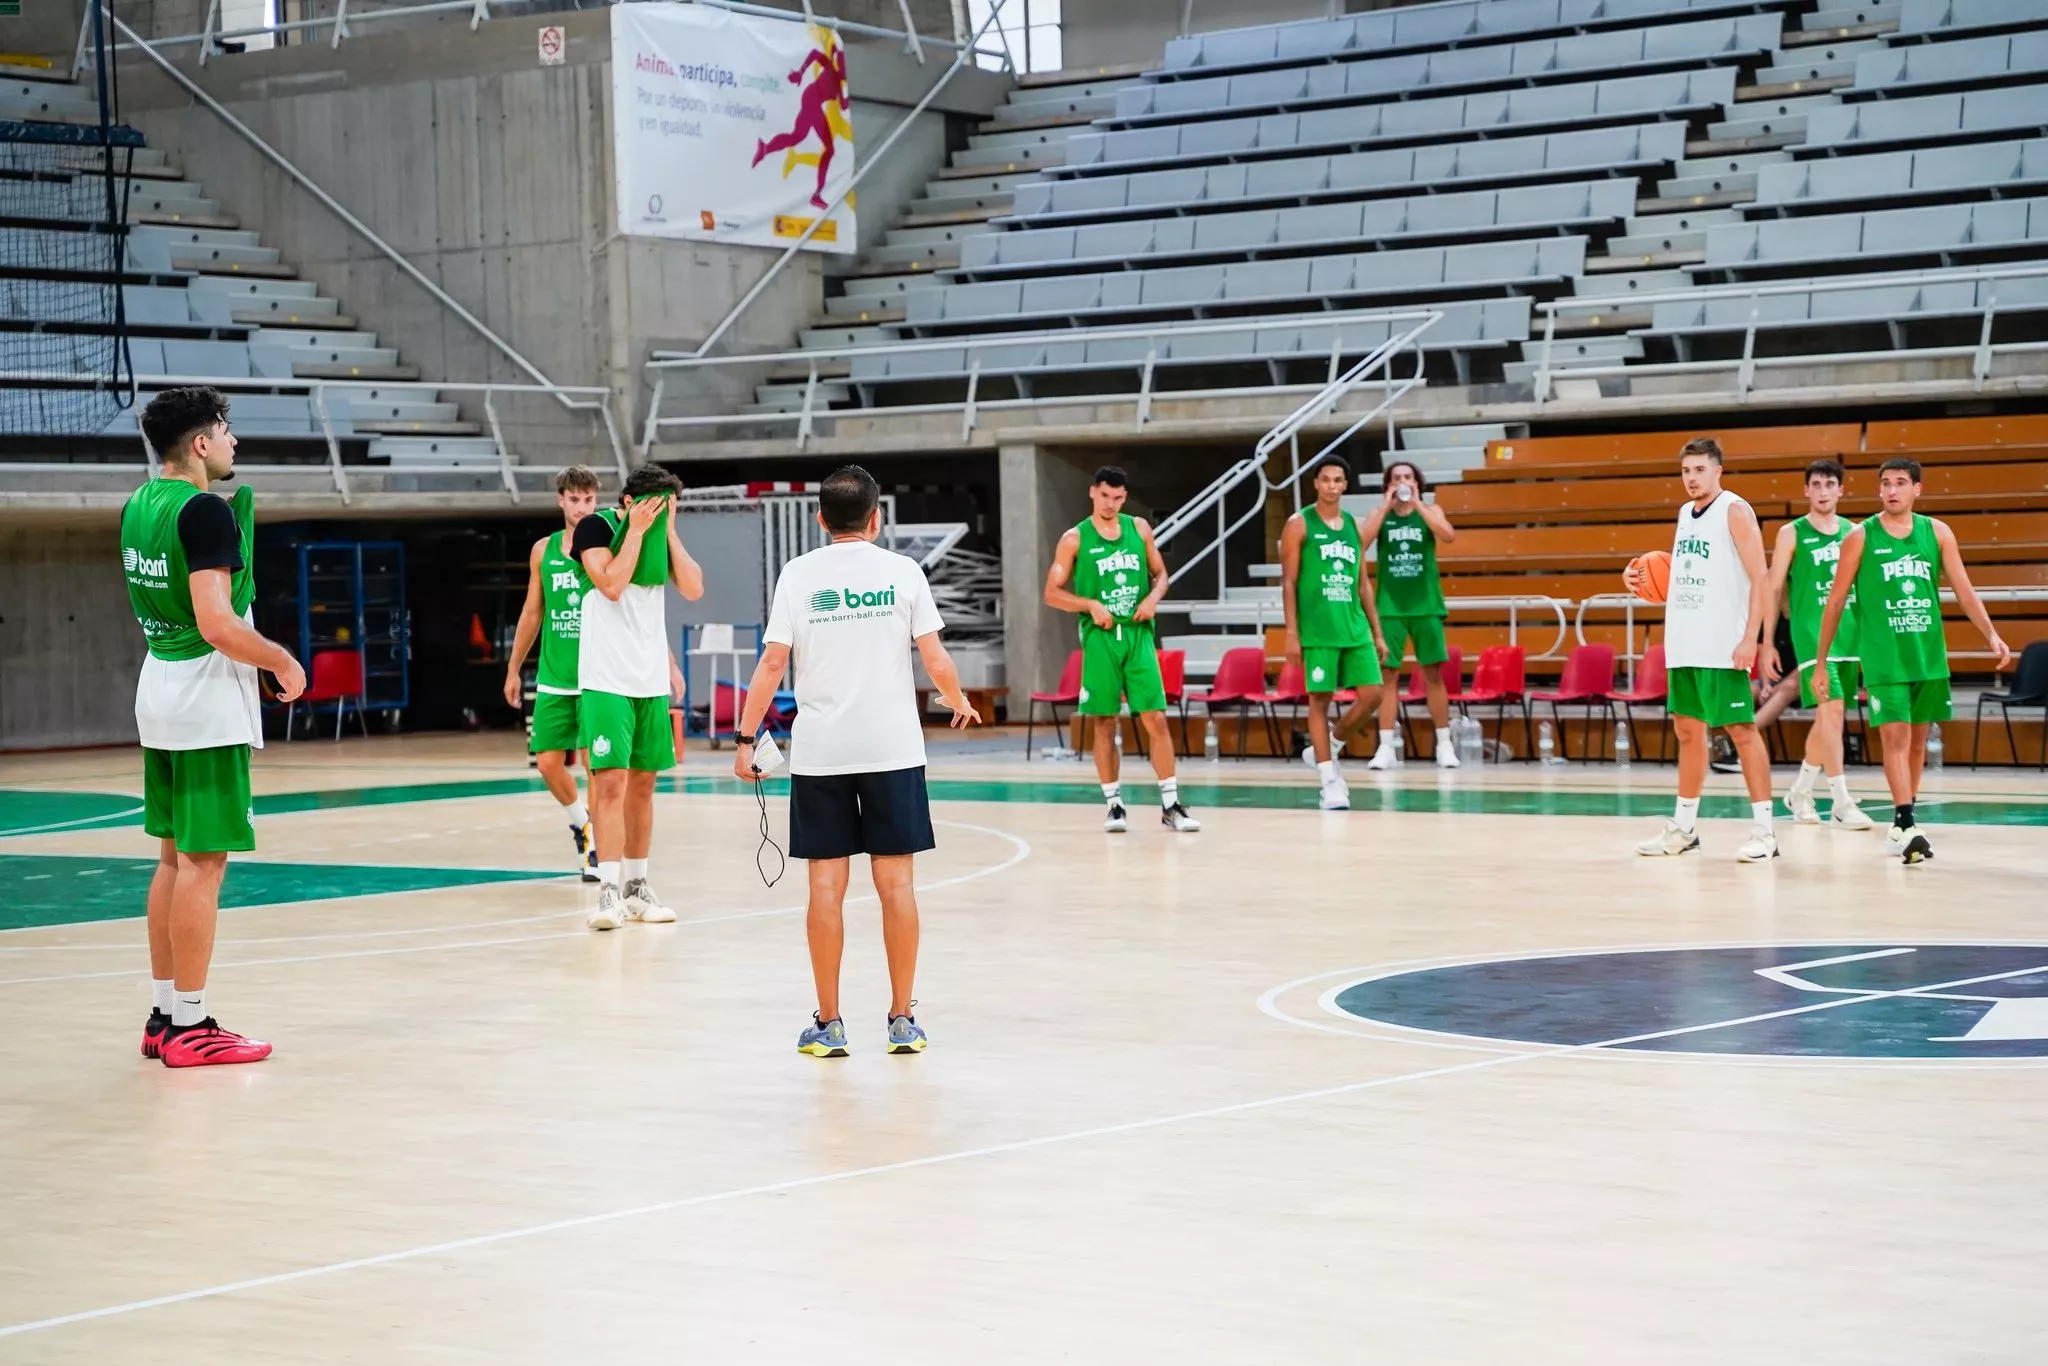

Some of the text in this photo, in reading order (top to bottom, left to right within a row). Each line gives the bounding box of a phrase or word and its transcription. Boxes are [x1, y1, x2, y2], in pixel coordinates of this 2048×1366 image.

[138, 550, 168, 577] barri
[844, 585, 895, 609] barri
[551, 607, 581, 620] Lob
[808, 610, 893, 625] www.barri-ball.com
